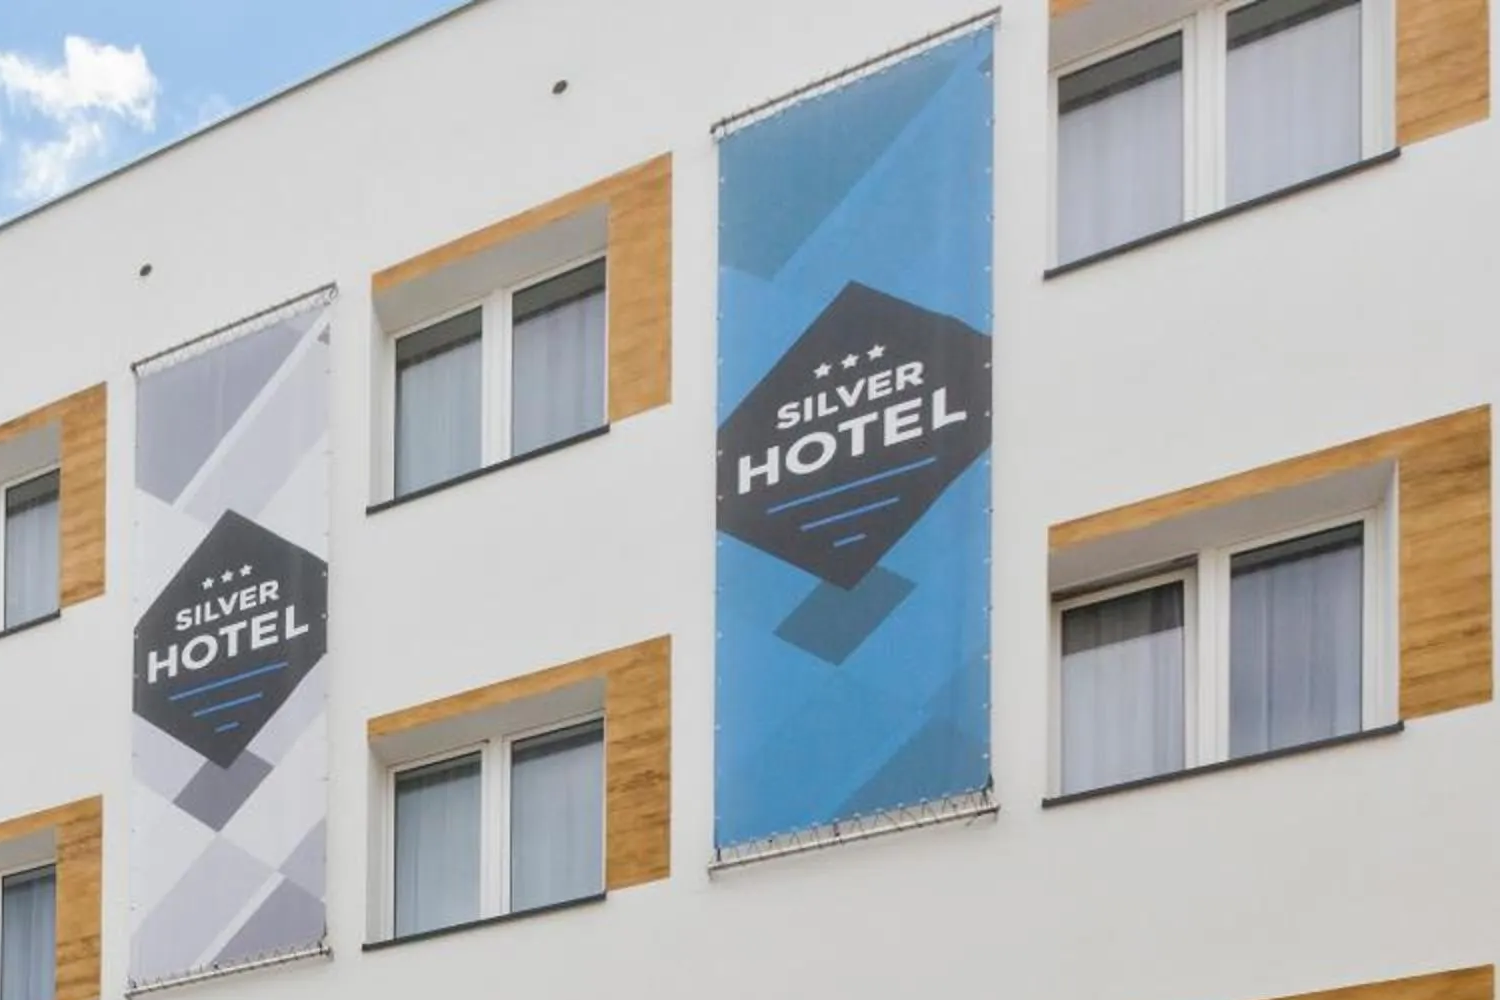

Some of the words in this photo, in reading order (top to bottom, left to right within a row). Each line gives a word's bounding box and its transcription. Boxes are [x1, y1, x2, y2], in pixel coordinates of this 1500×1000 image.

[776, 361, 925, 430] SILVER
[738, 387, 967, 494] HOTEL
[175, 580, 280, 631] SILVER
[147, 604, 309, 684] HOTEL
